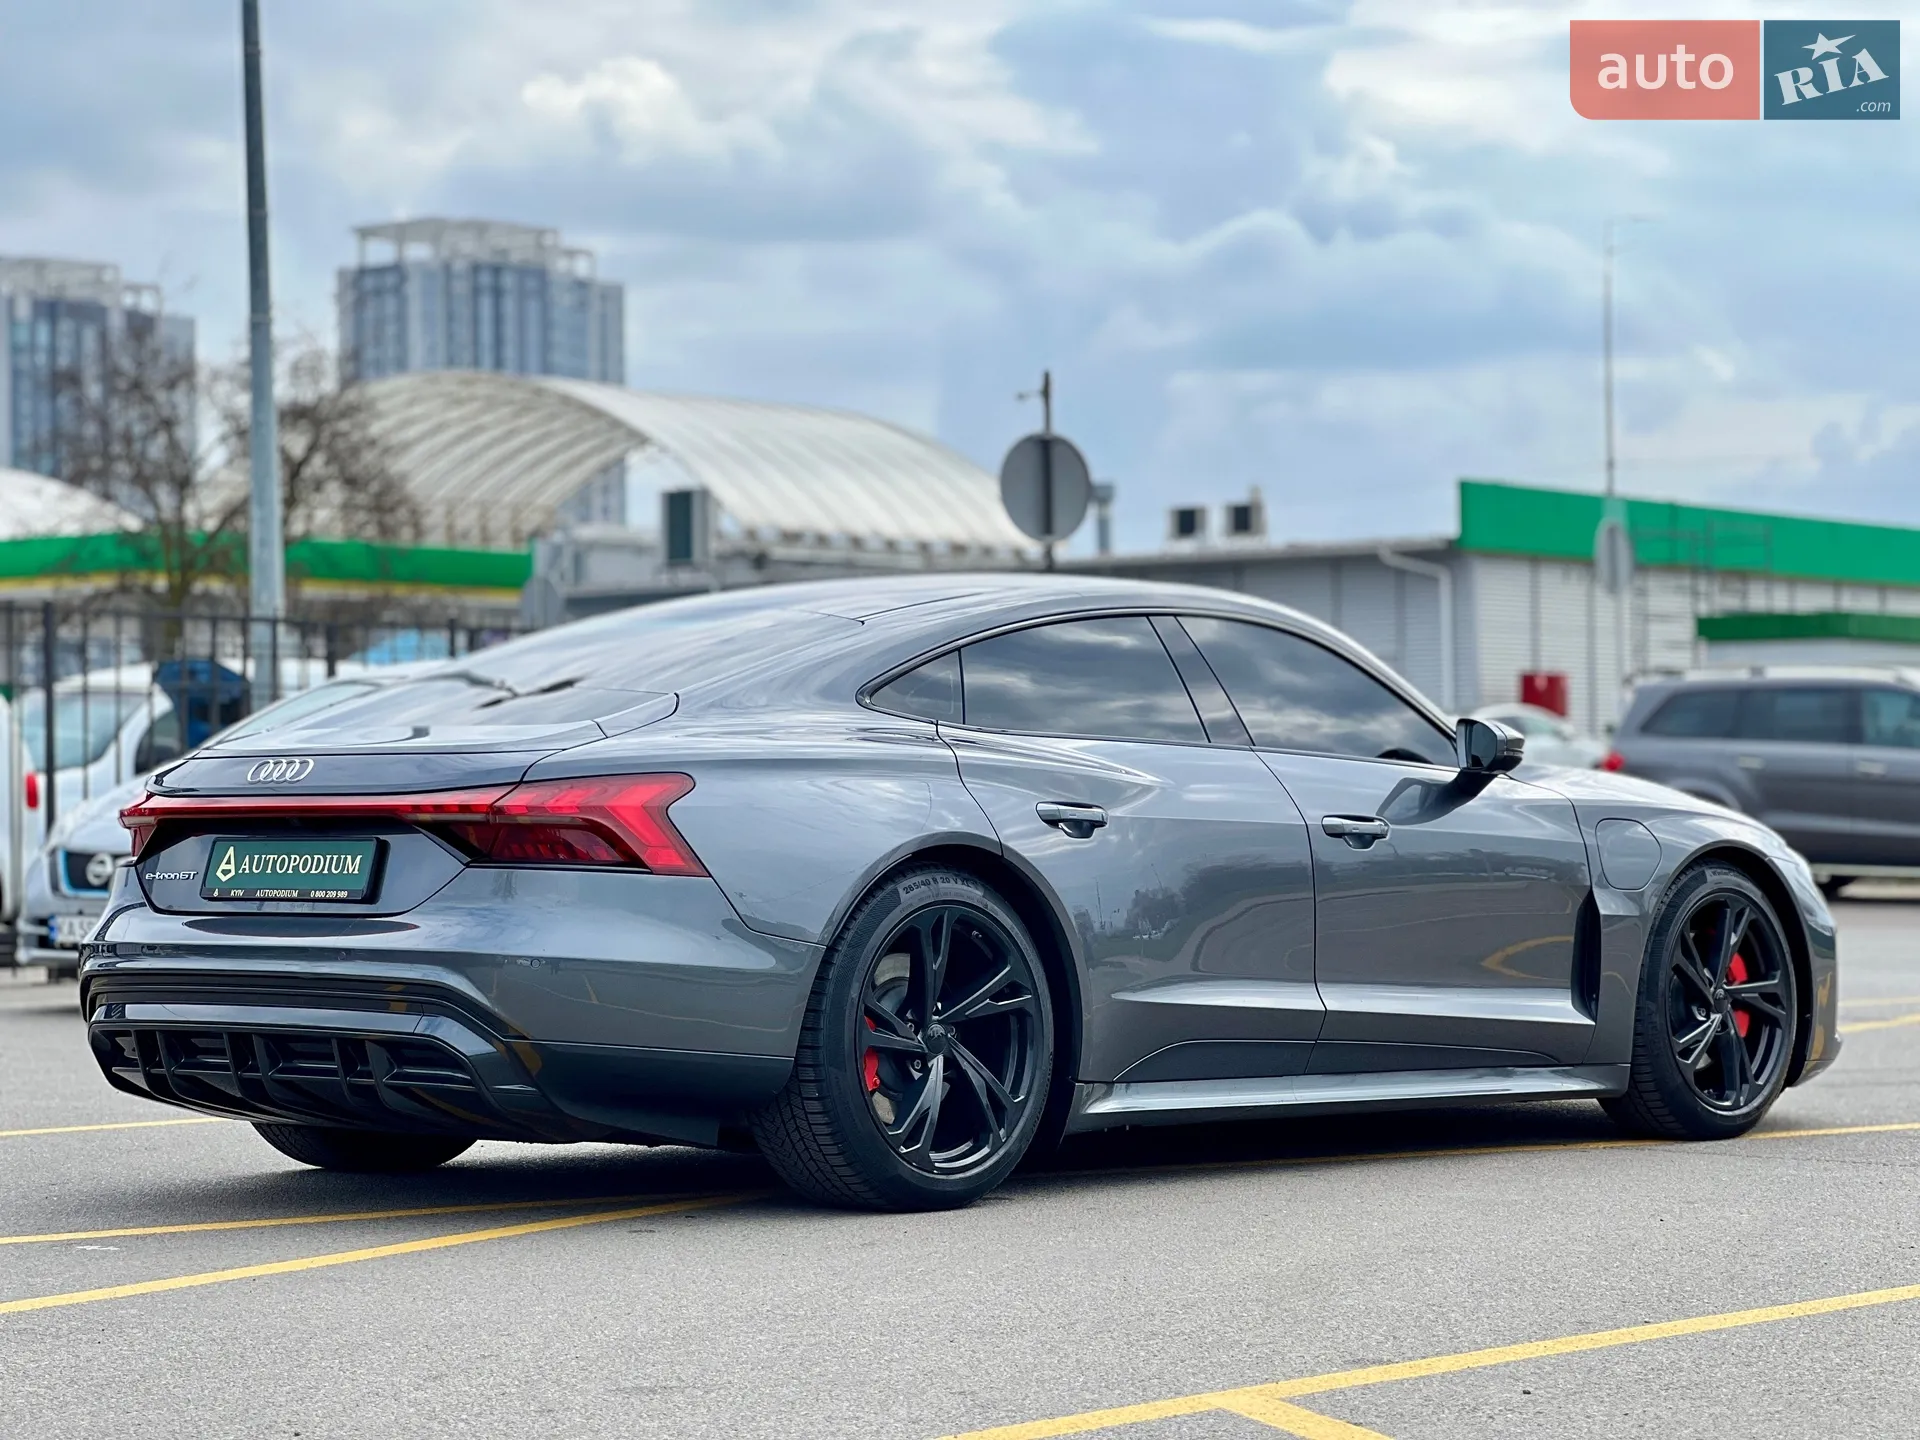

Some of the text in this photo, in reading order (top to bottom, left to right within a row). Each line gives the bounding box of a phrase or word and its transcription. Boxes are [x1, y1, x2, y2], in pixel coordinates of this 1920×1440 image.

[238, 854, 363, 874] AUTOPODIUM
[230, 889, 245, 897] KYIV
[255, 889, 300, 898] AUTOPODIUM
[310, 890, 315, 898] 0
[315, 890, 326, 898] 800
[326, 890, 337, 898] 209
[903, 878, 931, 894] 285/40
[931, 877, 939, 885] R
[940, 876, 951, 884] 20
[952, 877, 958, 885] V
